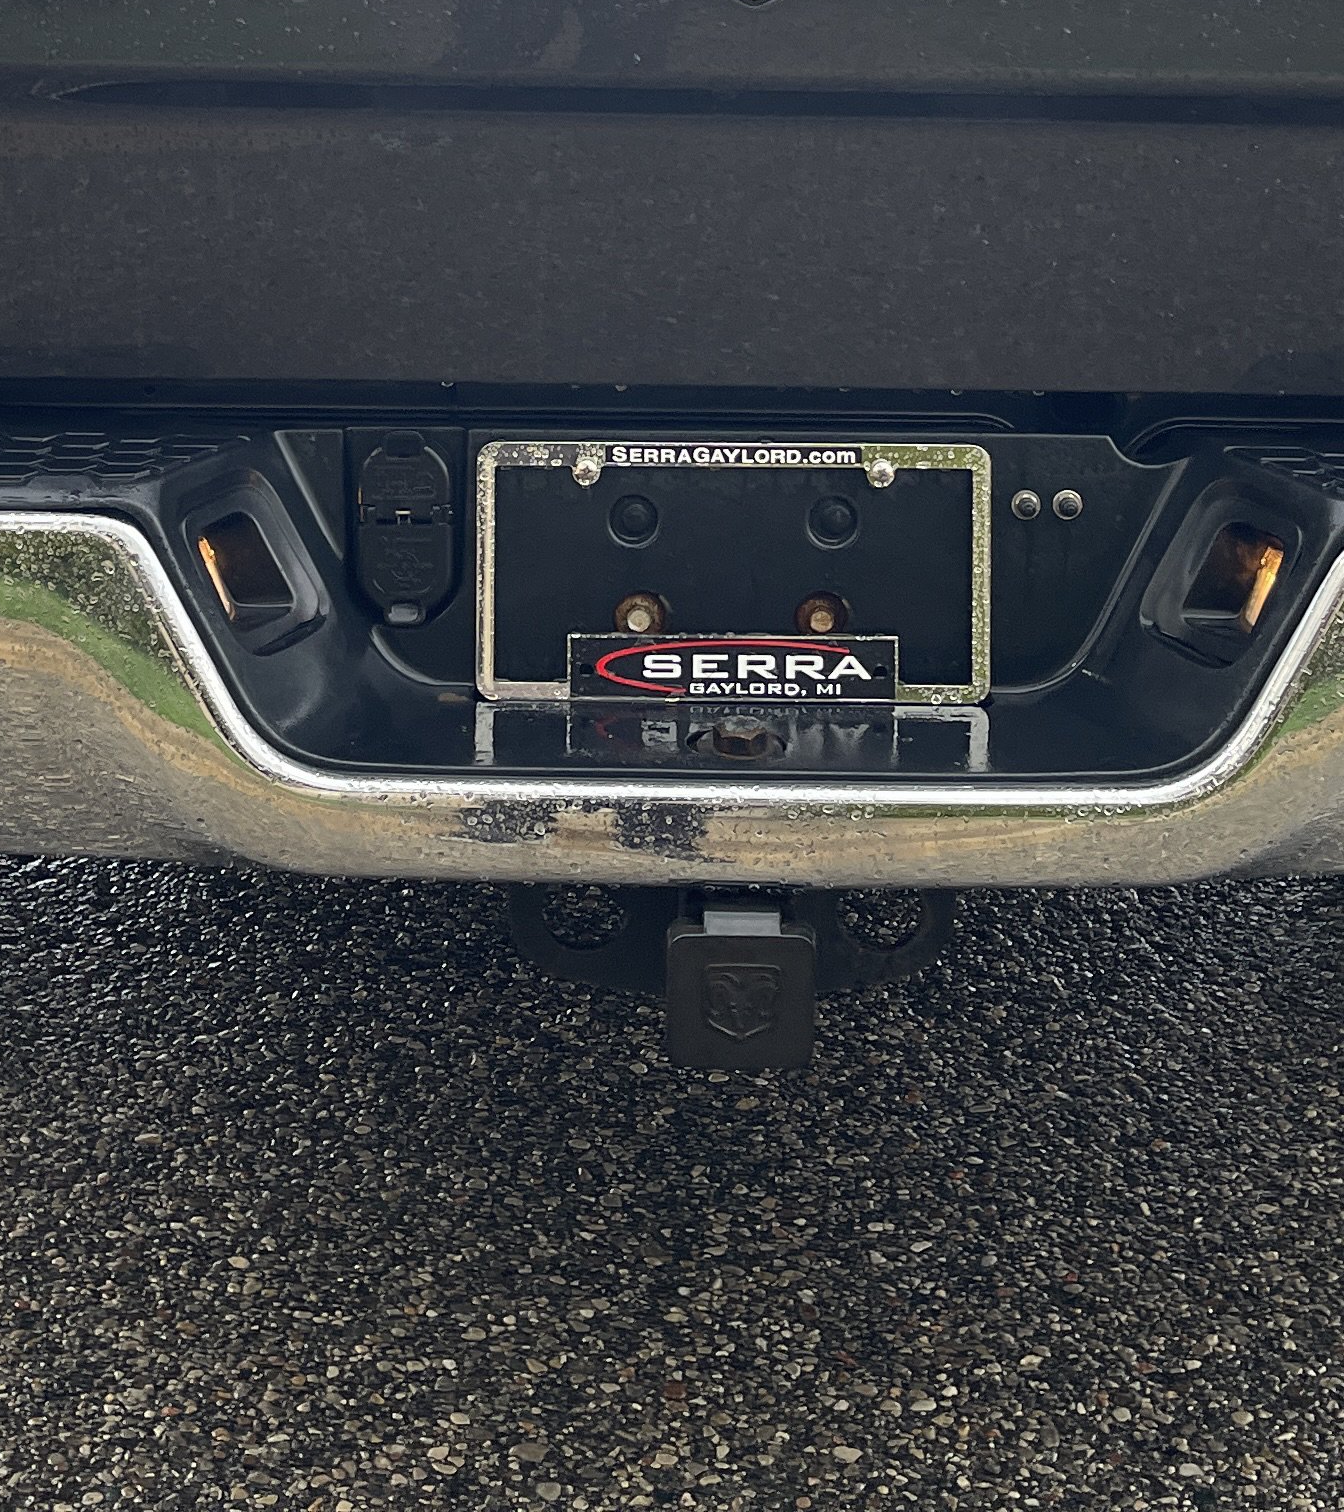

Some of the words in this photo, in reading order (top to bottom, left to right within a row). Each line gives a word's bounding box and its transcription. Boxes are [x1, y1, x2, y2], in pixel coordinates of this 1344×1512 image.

[611, 446, 856, 465] SERRAGAYLORD.com
[641, 654, 873, 681] SERRA
[689, 682, 807, 697] GAYLORD,
[816, 683, 842, 696] MI
